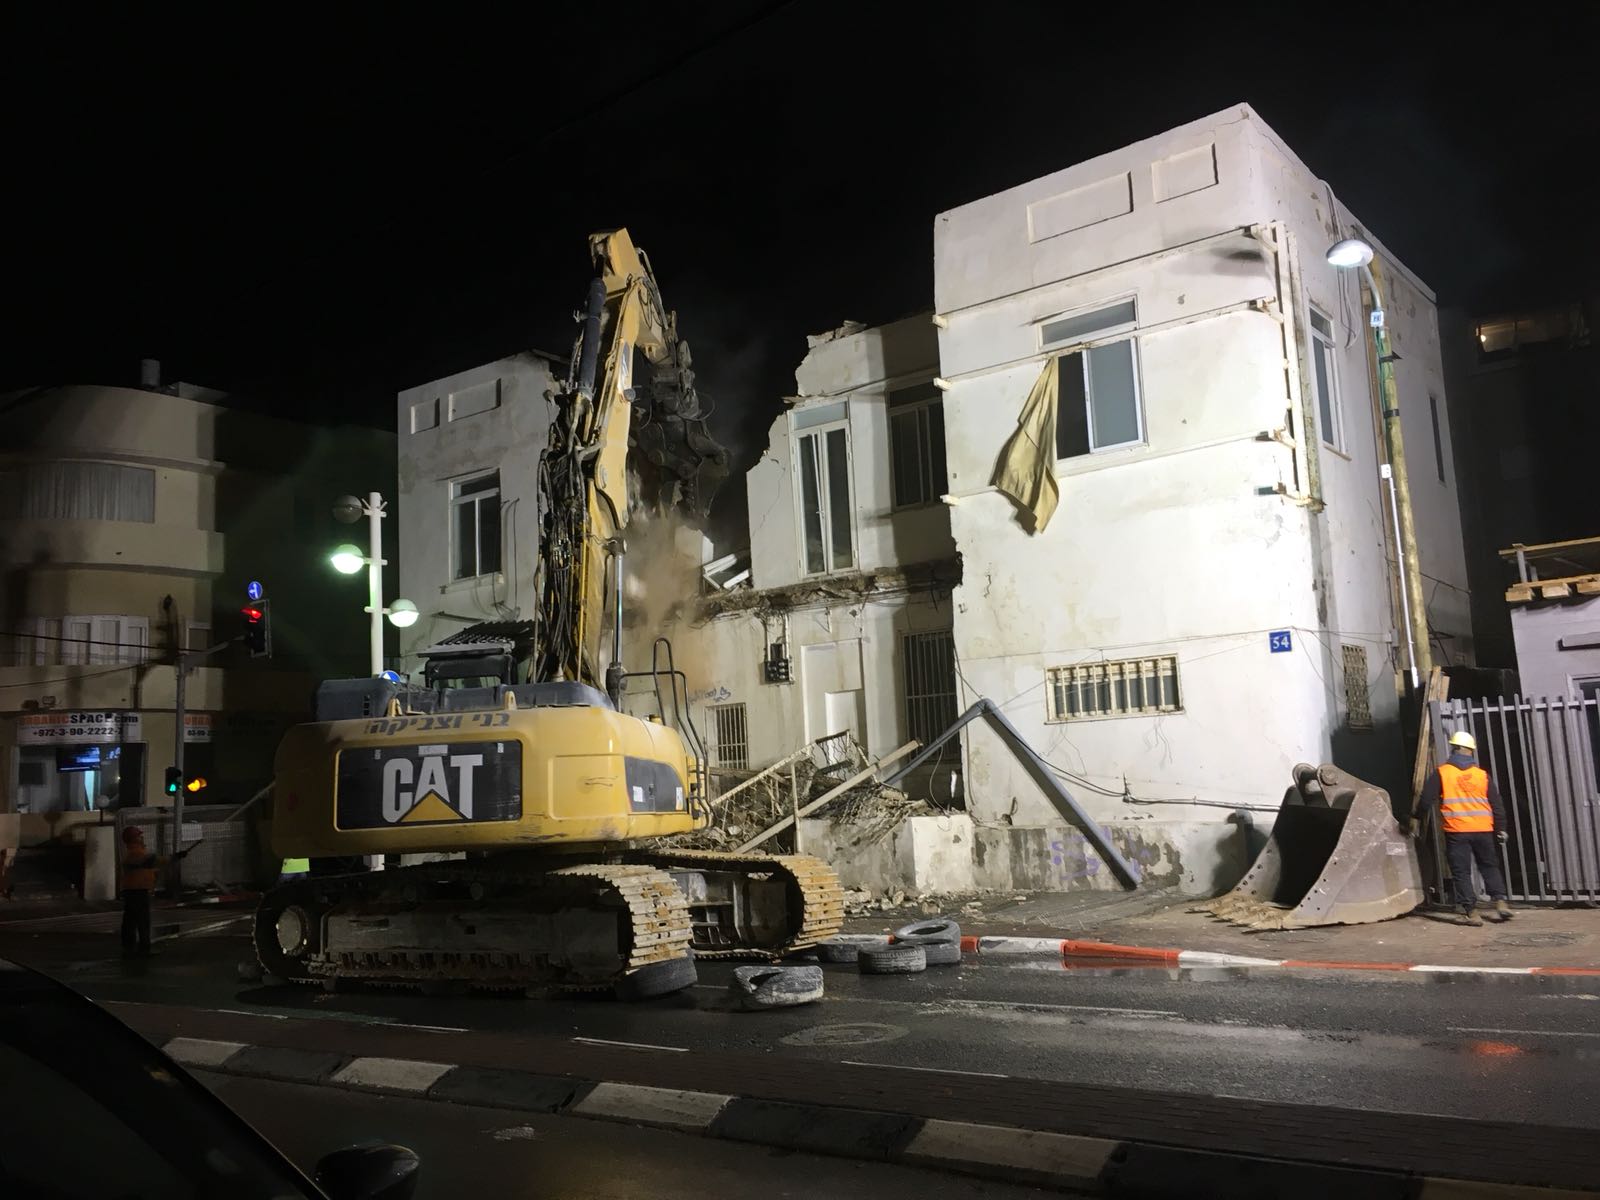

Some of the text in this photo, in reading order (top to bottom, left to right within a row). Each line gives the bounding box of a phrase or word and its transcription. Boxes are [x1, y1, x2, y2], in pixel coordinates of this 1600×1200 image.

[1272, 635, 1290, 650] 54
[472, 712, 511, 727] בני
[382, 754, 484, 823] CAT
